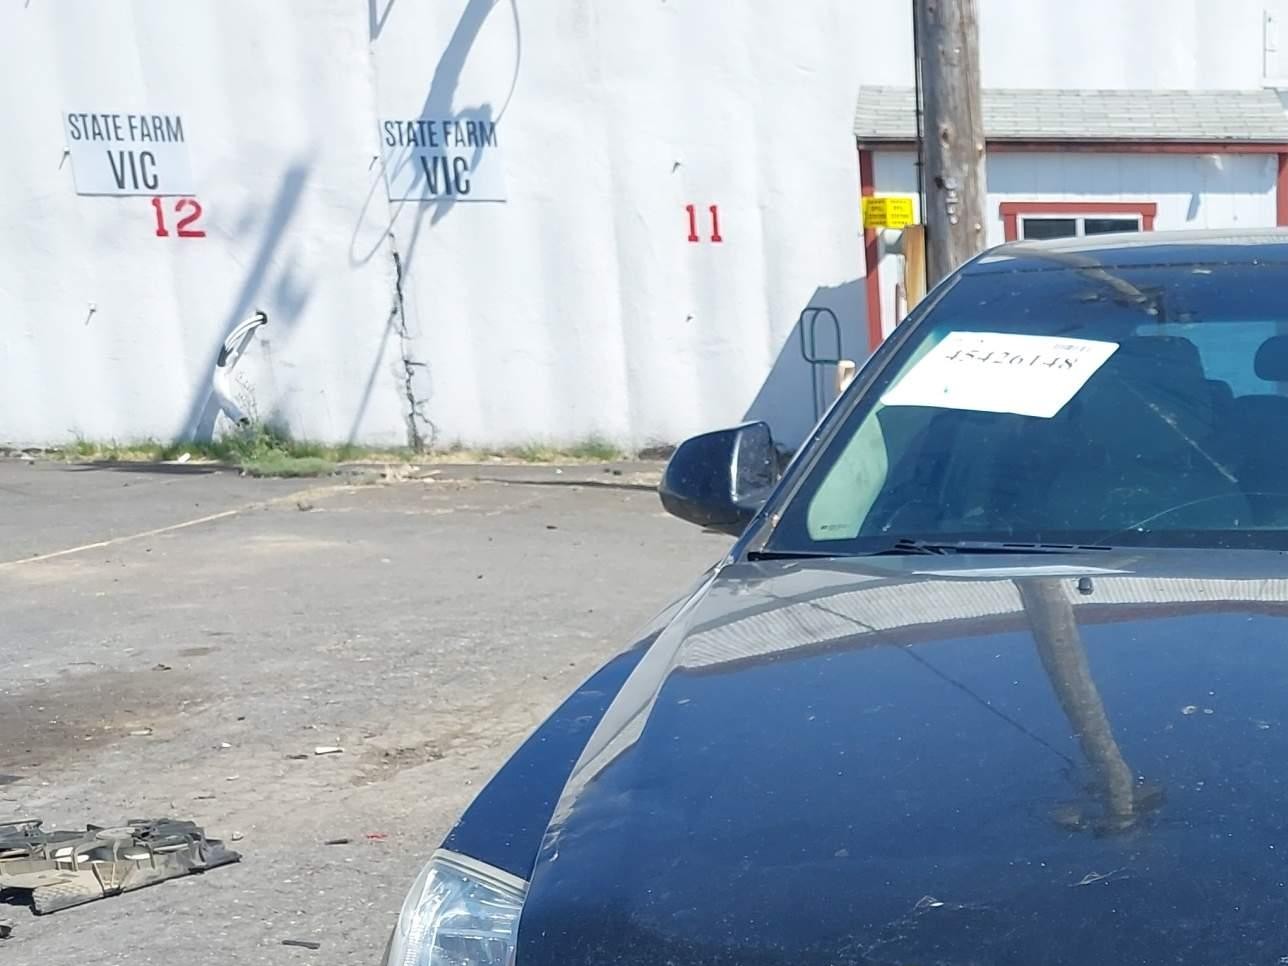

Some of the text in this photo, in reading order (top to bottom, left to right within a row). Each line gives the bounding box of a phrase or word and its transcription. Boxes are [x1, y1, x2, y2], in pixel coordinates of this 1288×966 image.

[68, 113, 184, 143] STATE FARM
[384, 120, 498, 148] STATE FARM
[107, 149, 159, 190] VIC
[420, 155, 471, 195] VIC
[152, 197, 205, 239] 12
[686, 204, 722, 243] 11
